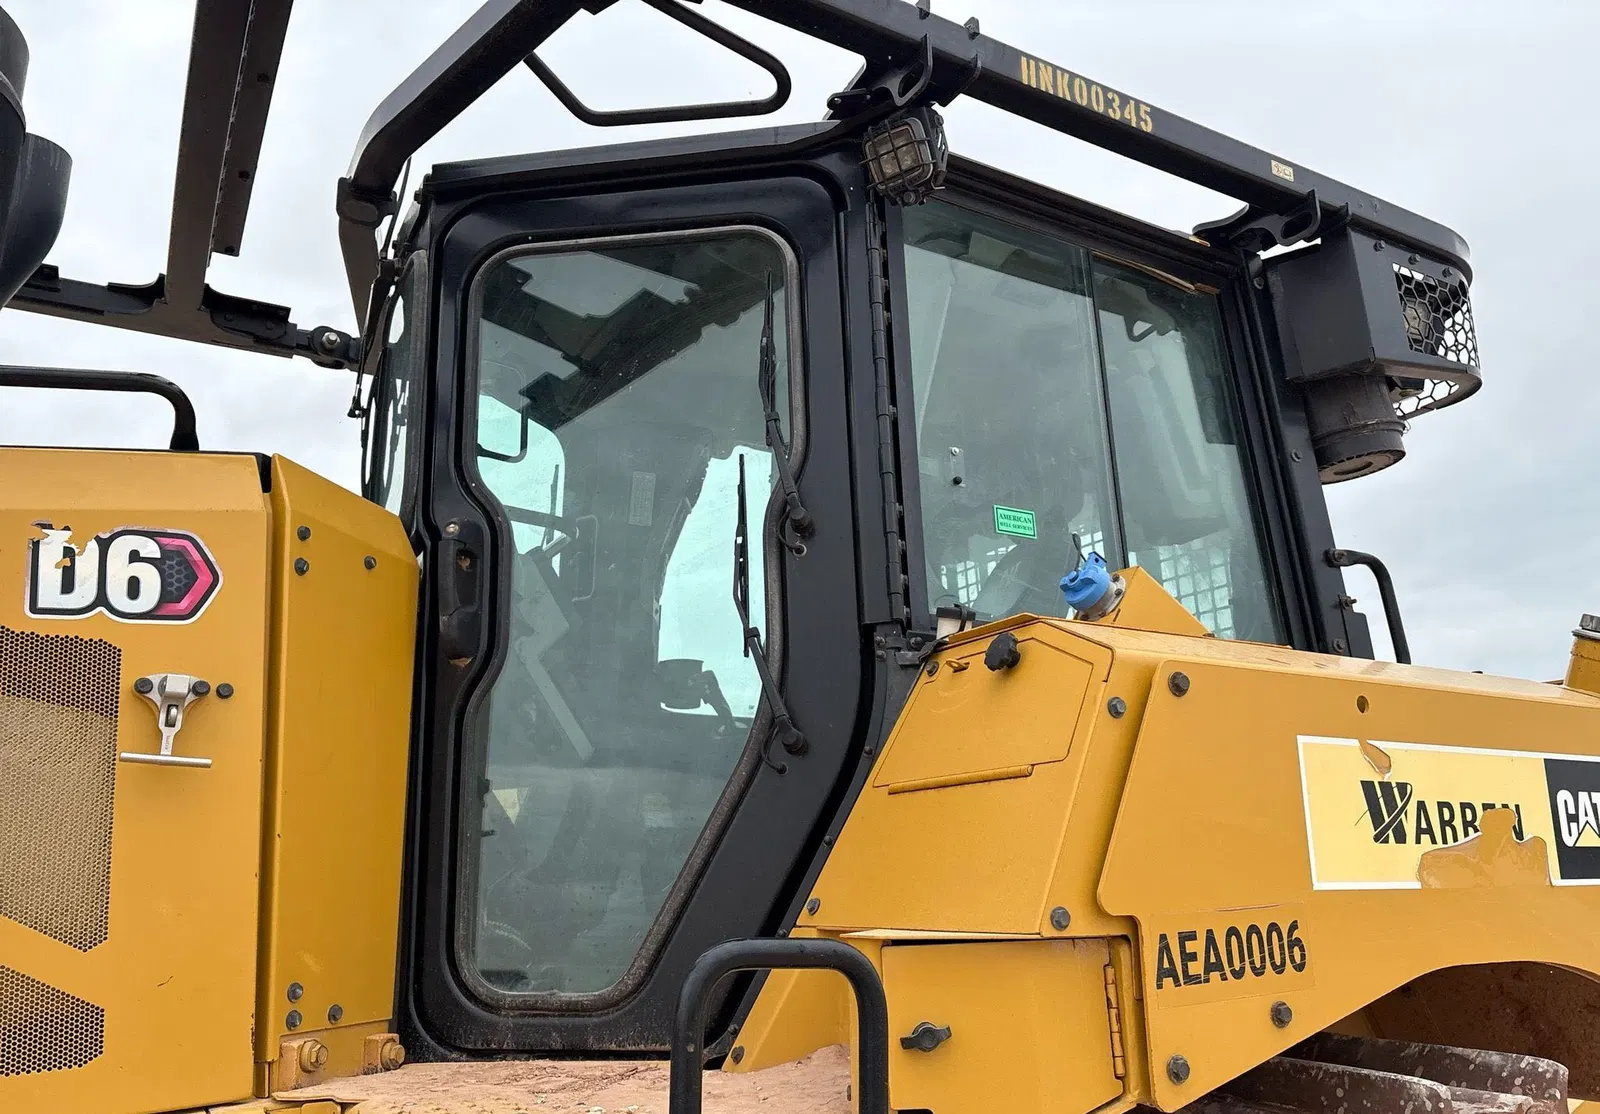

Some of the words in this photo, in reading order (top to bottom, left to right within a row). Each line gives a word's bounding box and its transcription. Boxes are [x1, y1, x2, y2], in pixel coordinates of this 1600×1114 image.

[999, 513, 1032, 524] AMERICAN
[1012, 523, 1033, 531] SERVICES
[36, 528, 162, 614] D6
[1359, 780, 1524, 845] WARRN
[1155, 920, 1307, 990] AEA0006
